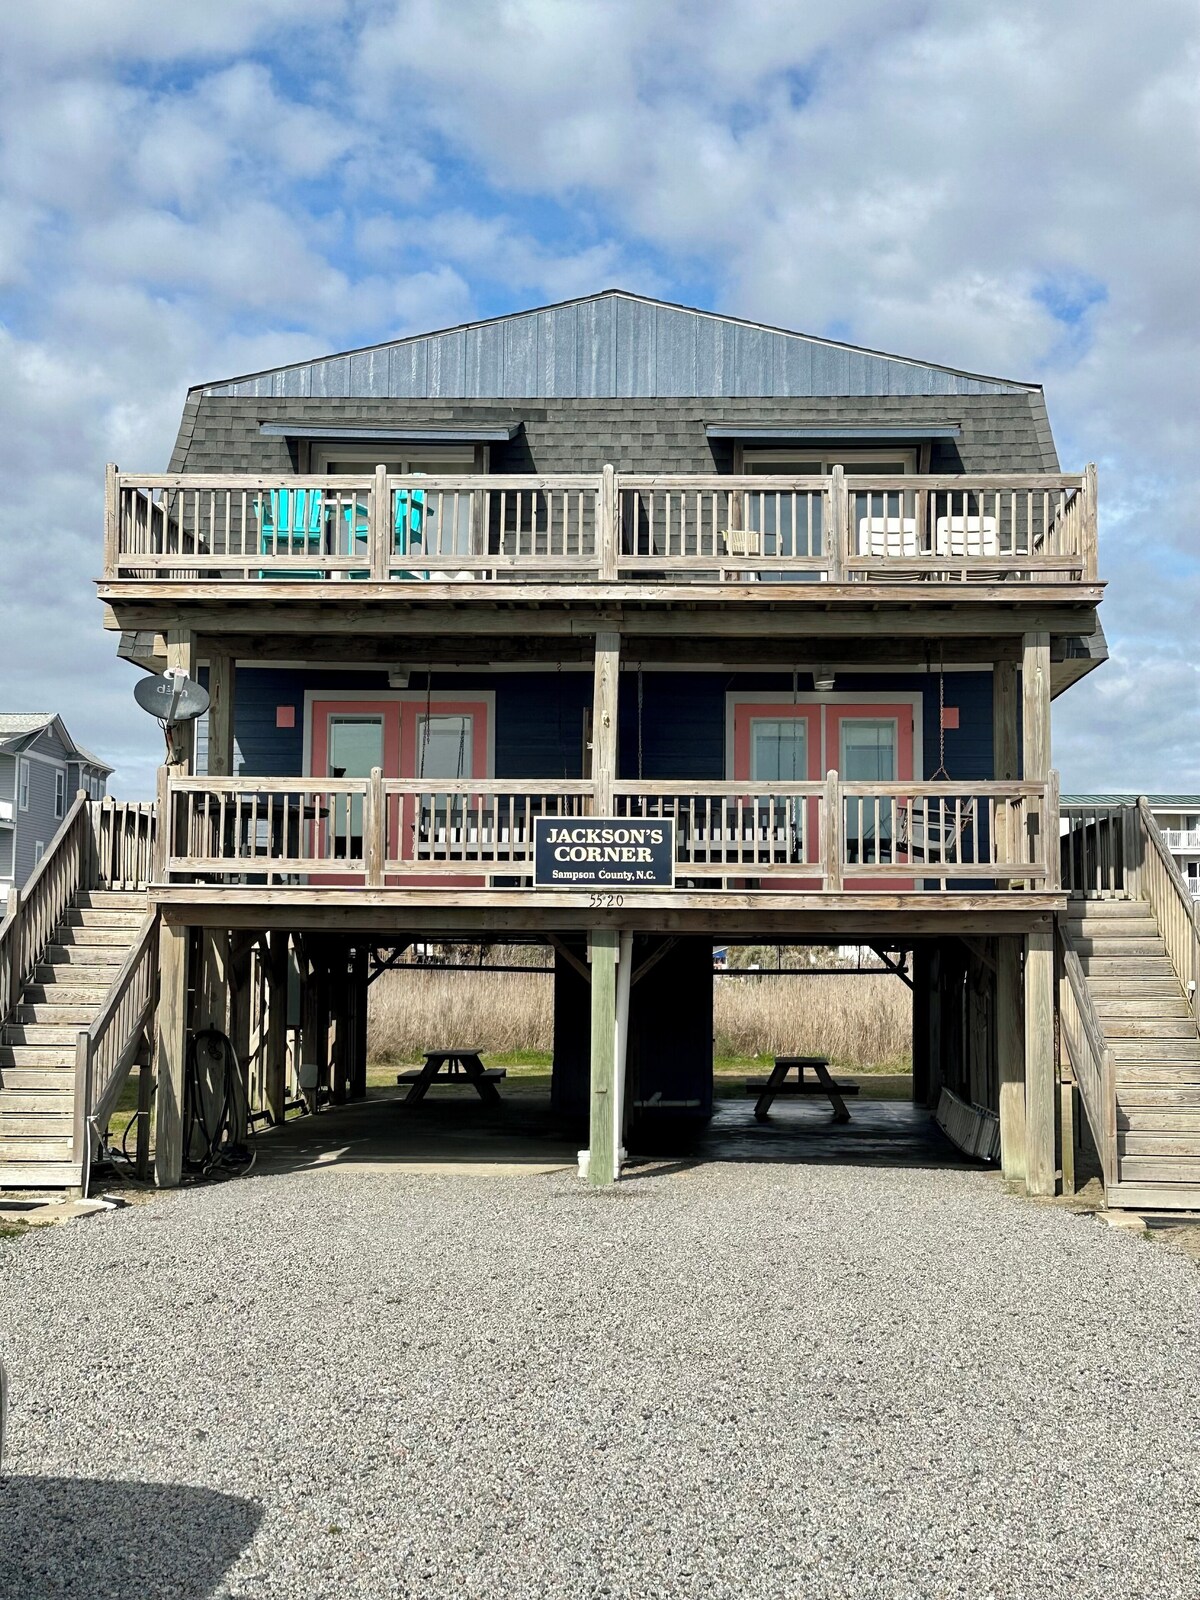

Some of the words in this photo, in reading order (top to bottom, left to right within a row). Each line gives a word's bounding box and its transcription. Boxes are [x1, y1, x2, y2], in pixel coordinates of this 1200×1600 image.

[546, 828, 663, 844] JACKSON'S
[554, 846, 654, 862] CORNER
[552, 869, 595, 880] Sampson
[598, 870, 635, 881] County,
[636, 870, 656, 880] N.C.
[589, 894, 624, 908] 5520
